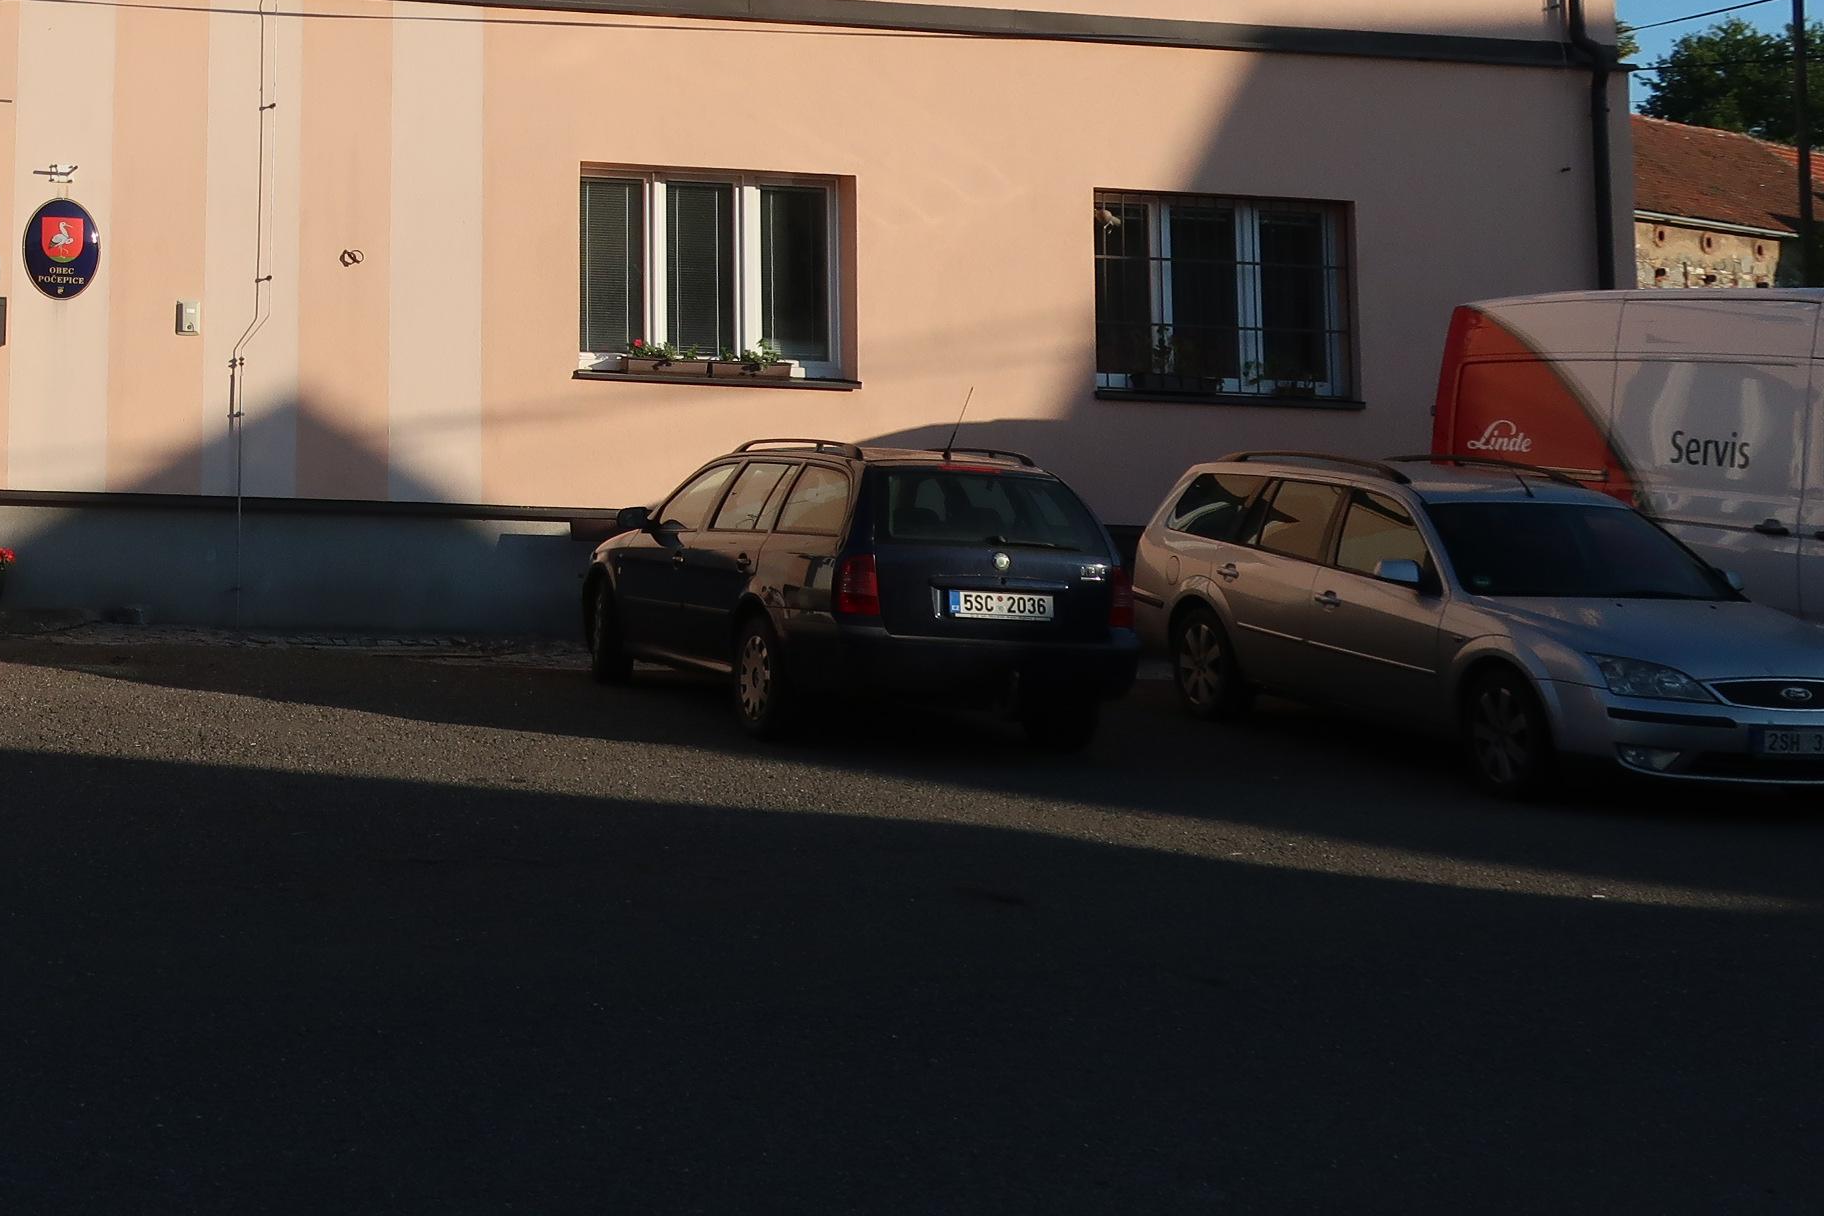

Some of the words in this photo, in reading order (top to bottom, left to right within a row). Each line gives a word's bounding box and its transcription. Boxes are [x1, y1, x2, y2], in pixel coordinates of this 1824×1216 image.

[38, 273, 84, 285] POČEPICE
[49, 266, 75, 275] OBEC
[1467, 420, 1531, 452] Linde
[1670, 430, 1750, 470] Servis
[963, 594, 995, 613] 5SC
[1007, 596, 1047, 615] 2036
[1768, 733, 1801, 752] 2SH
[1813, 734, 1824, 752] 3
